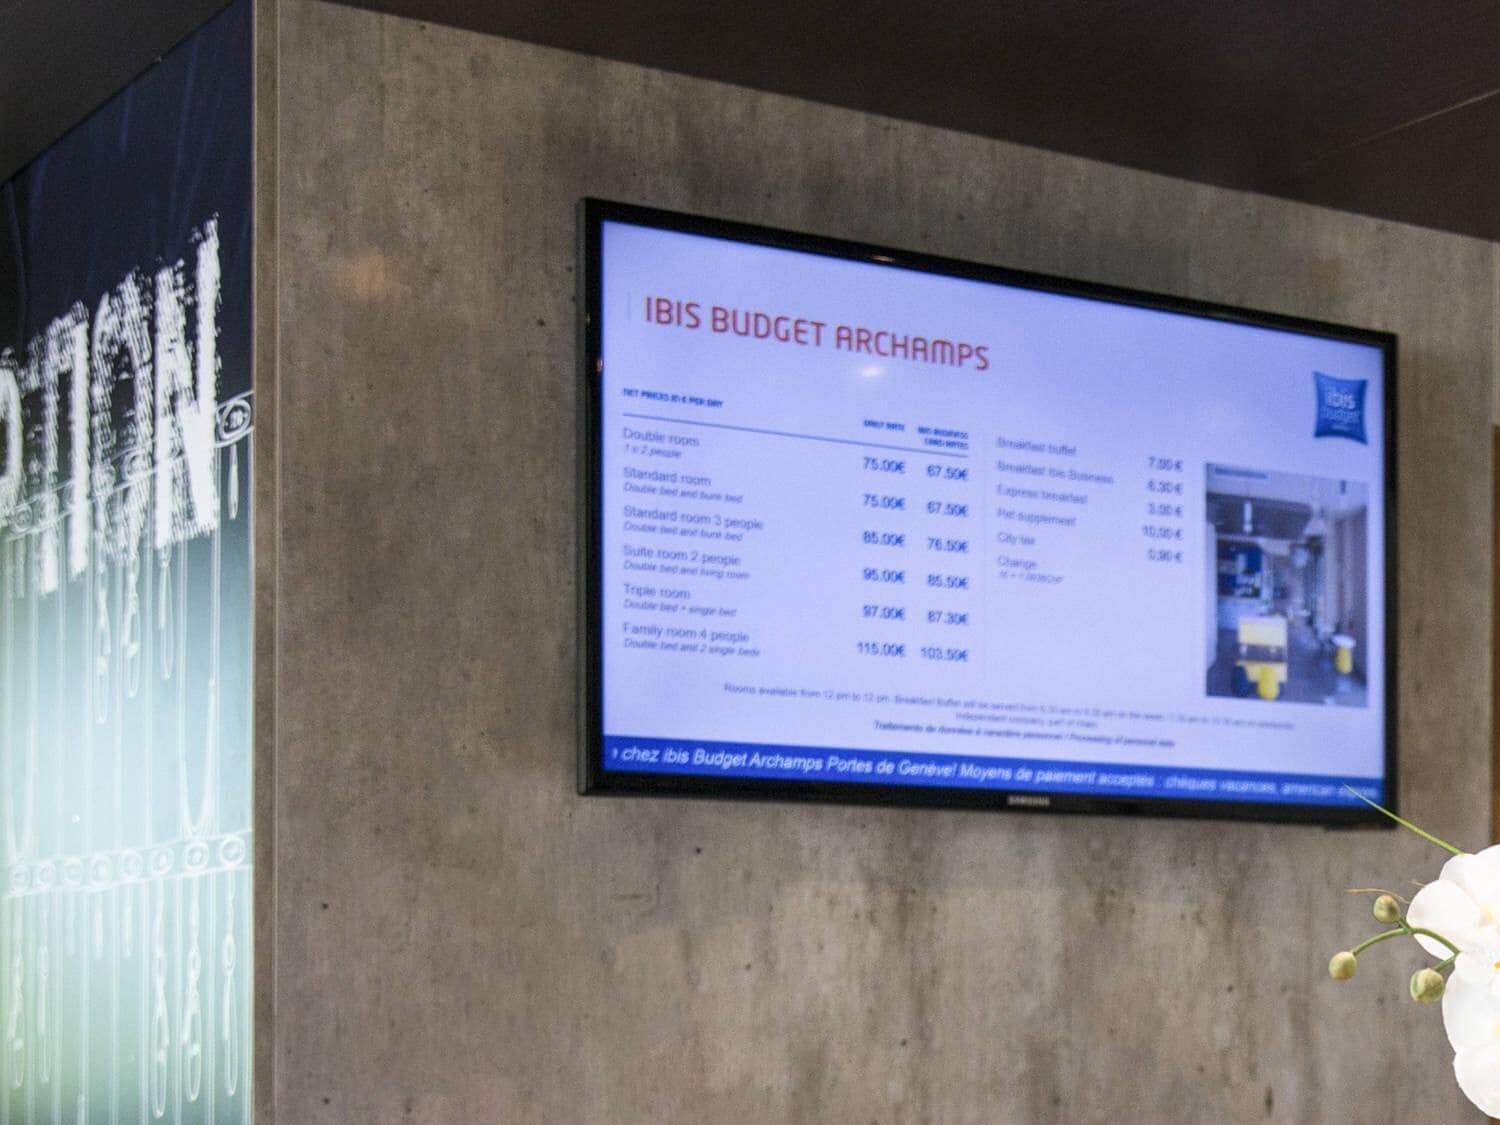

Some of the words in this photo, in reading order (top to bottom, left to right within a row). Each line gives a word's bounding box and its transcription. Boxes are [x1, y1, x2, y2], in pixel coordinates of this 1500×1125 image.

[646, 296, 701, 329] IBIS
[711, 306, 826, 347] BUDGET
[836, 324, 990, 371] ARCHAMPS
[623, 426, 665, 443] Double
[669, 434, 700, 447] room
[623, 467, 678, 484] Standard
[681, 475, 711, 487] room
[623, 505, 678, 522] Standard
[681, 513, 711, 525] room
[725, 518, 764, 531] people
[657, 548, 688, 561] room
[701, 554, 741, 567] people
[659, 588, 691, 600] room
[623, 622, 663, 638] Family
[666, 627, 697, 638] room
[710, 631, 750, 643] people
[620, 747, 659, 763] chez
[663, 748, 690, 764] ibis
[693, 750, 747, 770] Budget
[749, 755, 823, 774] Archamps
[827, 756, 873, 774] Portes
[876, 759, 895, 774] de
[959, 763, 1012, 782] Moyens
[1015, 766, 1031, 782] de
[1034, 768, 1097, 787] paiement
